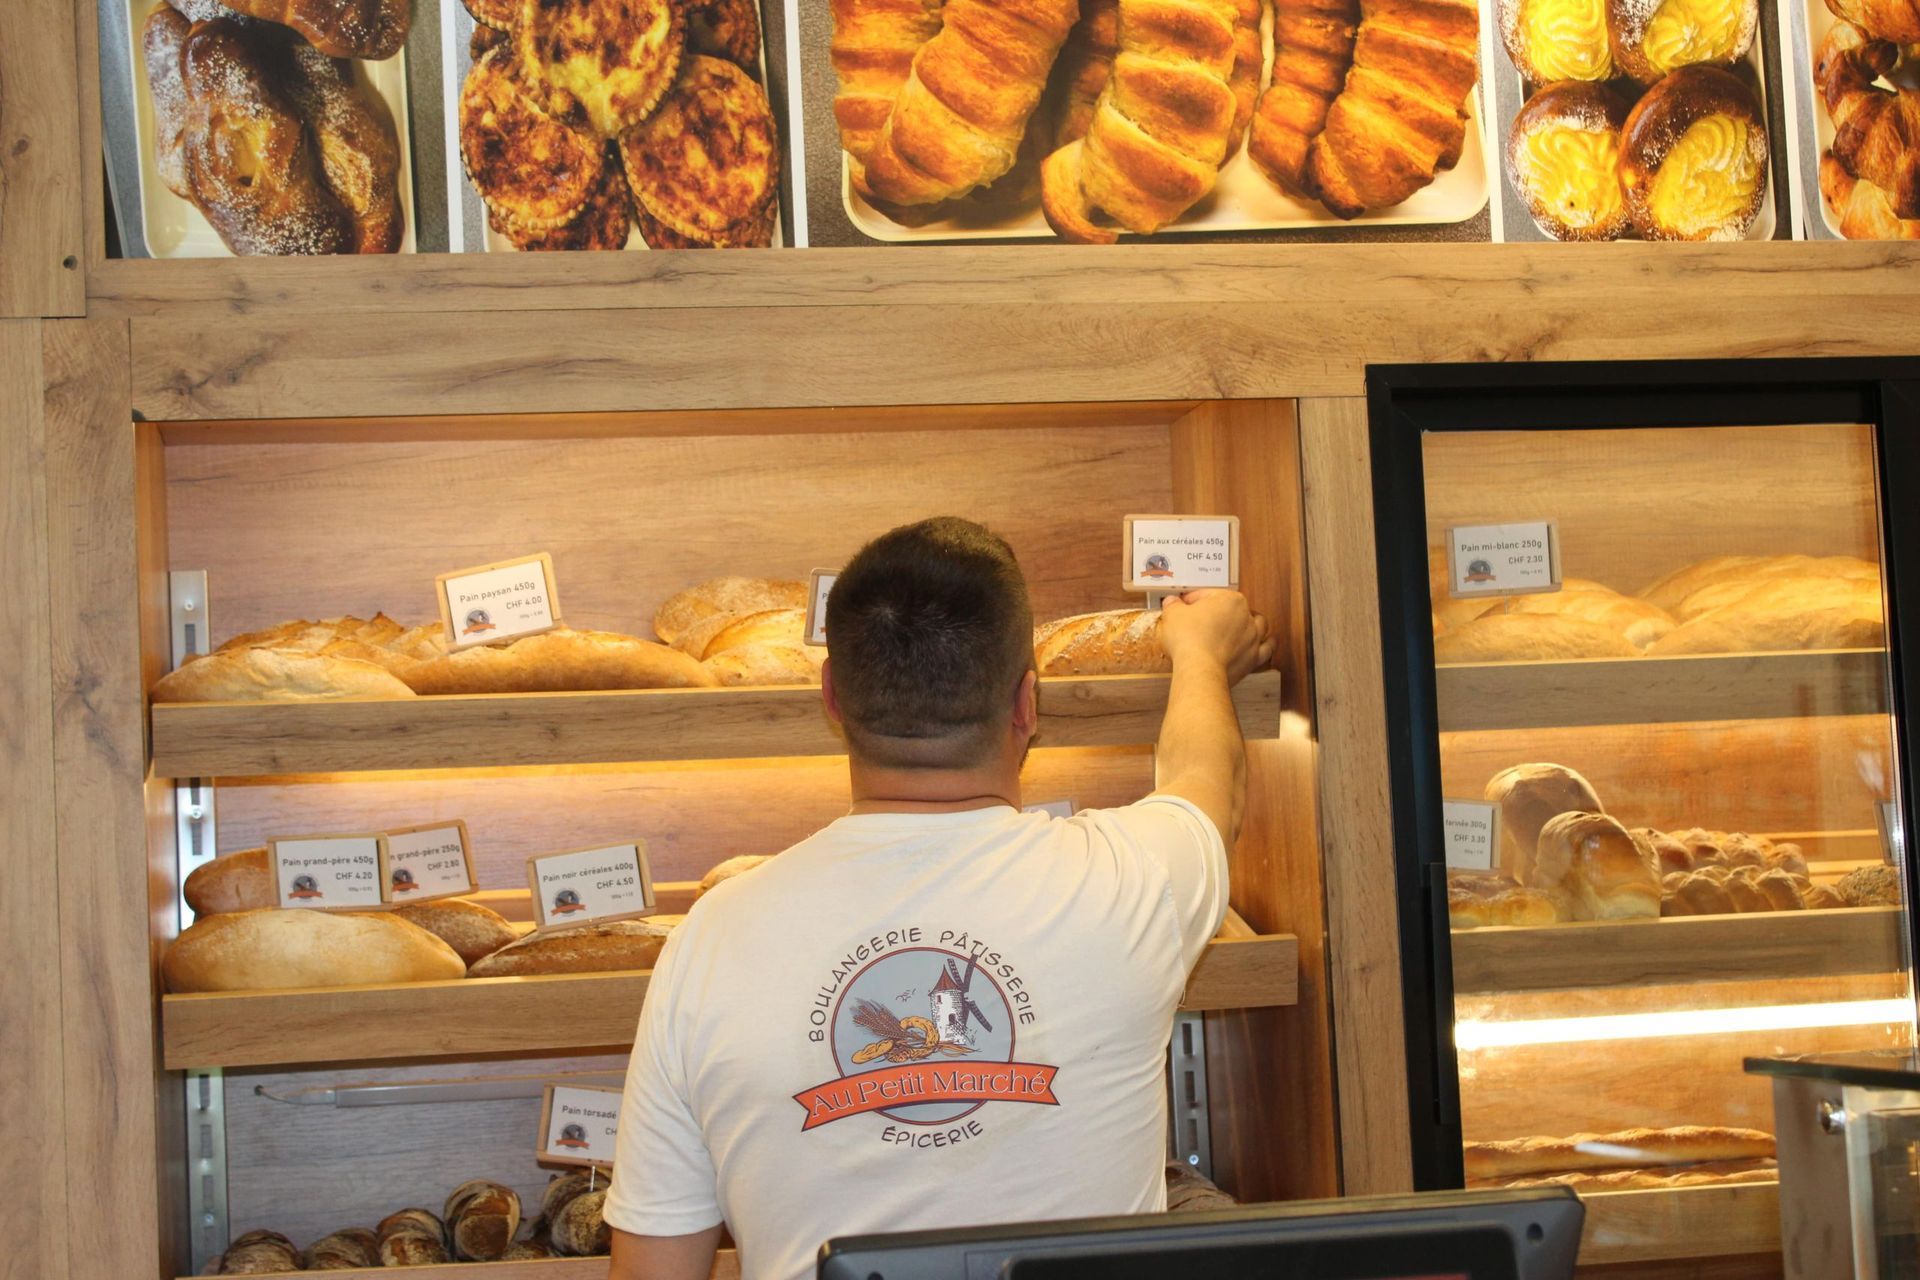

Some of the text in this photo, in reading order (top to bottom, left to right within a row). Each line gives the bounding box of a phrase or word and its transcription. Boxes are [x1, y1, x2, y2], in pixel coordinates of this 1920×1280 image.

[1138, 537, 1155, 545] Pain
[1172, 537, 1203, 545] céréales
[1206, 537, 1224, 546] 450g
[1461, 539, 1542, 552] Pain mi-blanc 250g
[1187, 552, 1223, 560] CHF 4.50
[1508, 556, 1525, 565] CHF
[460, 581, 536, 603] Pain paysan 450g
[506, 595, 542, 610] CHF 4.00
[1453, 833, 1469, 842] CHF
[396, 846, 440, 862] grand-père
[441, 843, 460, 854] 250g
[282, 855, 374, 867] Pain grand-père 450g
[427, 861, 442, 871] CHF
[335, 871, 373, 880] CHF 4.20
[543, 862, 634, 883] Pain noir céréales 400g
[596, 876, 634, 890] CHF 4.50
[808, 927, 1036, 1043] BOULANGERIE PÂTISSERIE
[810, 1069, 1047, 1118] Au Petit Marché
[561, 1105, 617, 1120] Pain torsadé
[605, 1127, 617, 1136] CH
[881, 1119, 984, 1149] ÉPICERIE
